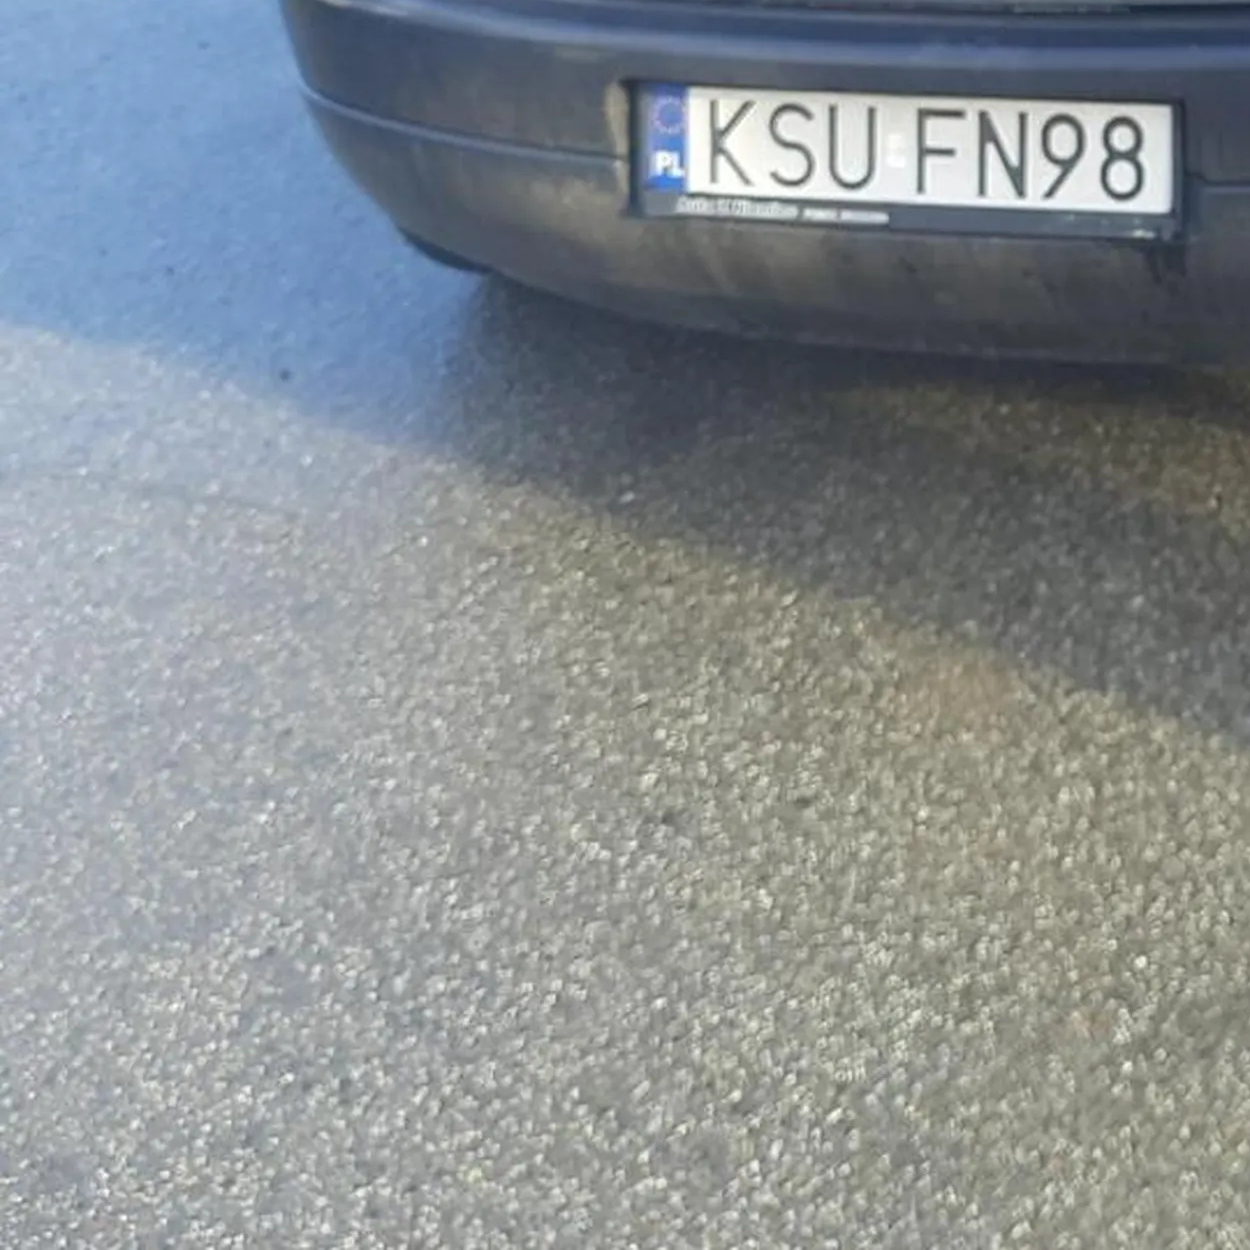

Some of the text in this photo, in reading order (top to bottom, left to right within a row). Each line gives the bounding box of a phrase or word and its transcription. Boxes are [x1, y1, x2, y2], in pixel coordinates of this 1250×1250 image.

[656, 151, 685, 178] PL
[708, 98, 1145, 202] KSU FN98
